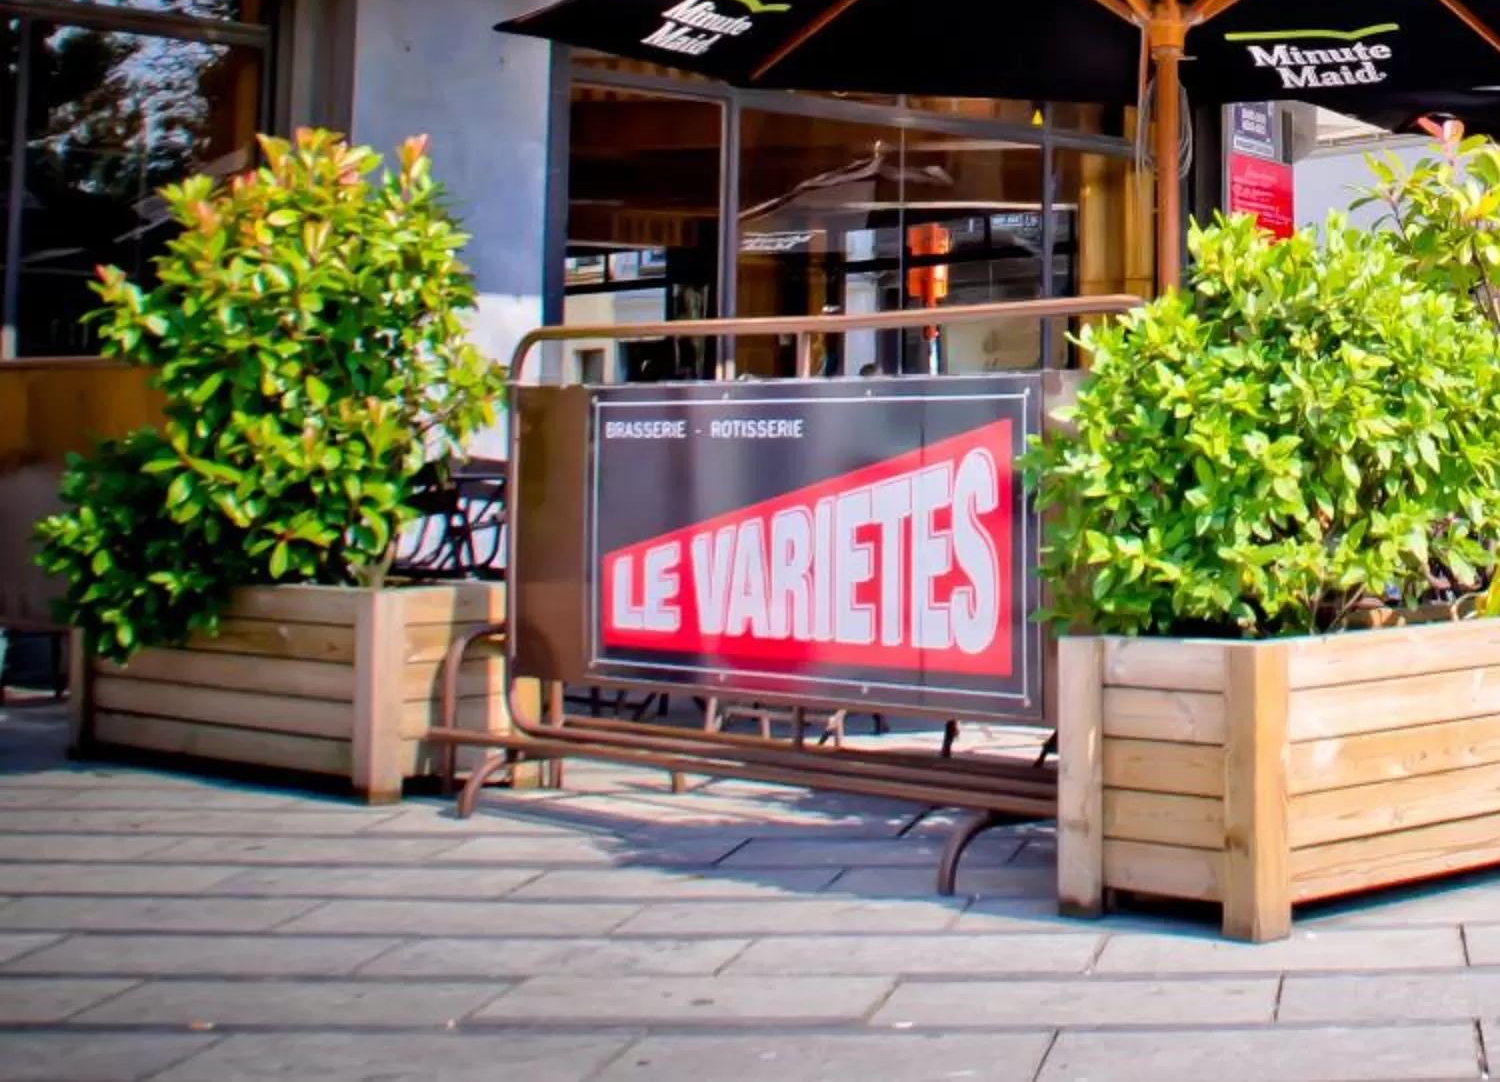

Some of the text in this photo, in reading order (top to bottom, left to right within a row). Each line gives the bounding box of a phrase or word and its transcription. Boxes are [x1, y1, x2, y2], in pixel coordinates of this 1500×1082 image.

[1247, 42, 1392, 67] Minute
[605, 420, 687, 439] BRASSERIE
[710, 418, 804, 439] ROTISSERIE
[611, 446, 999, 655] LE VARIETES
